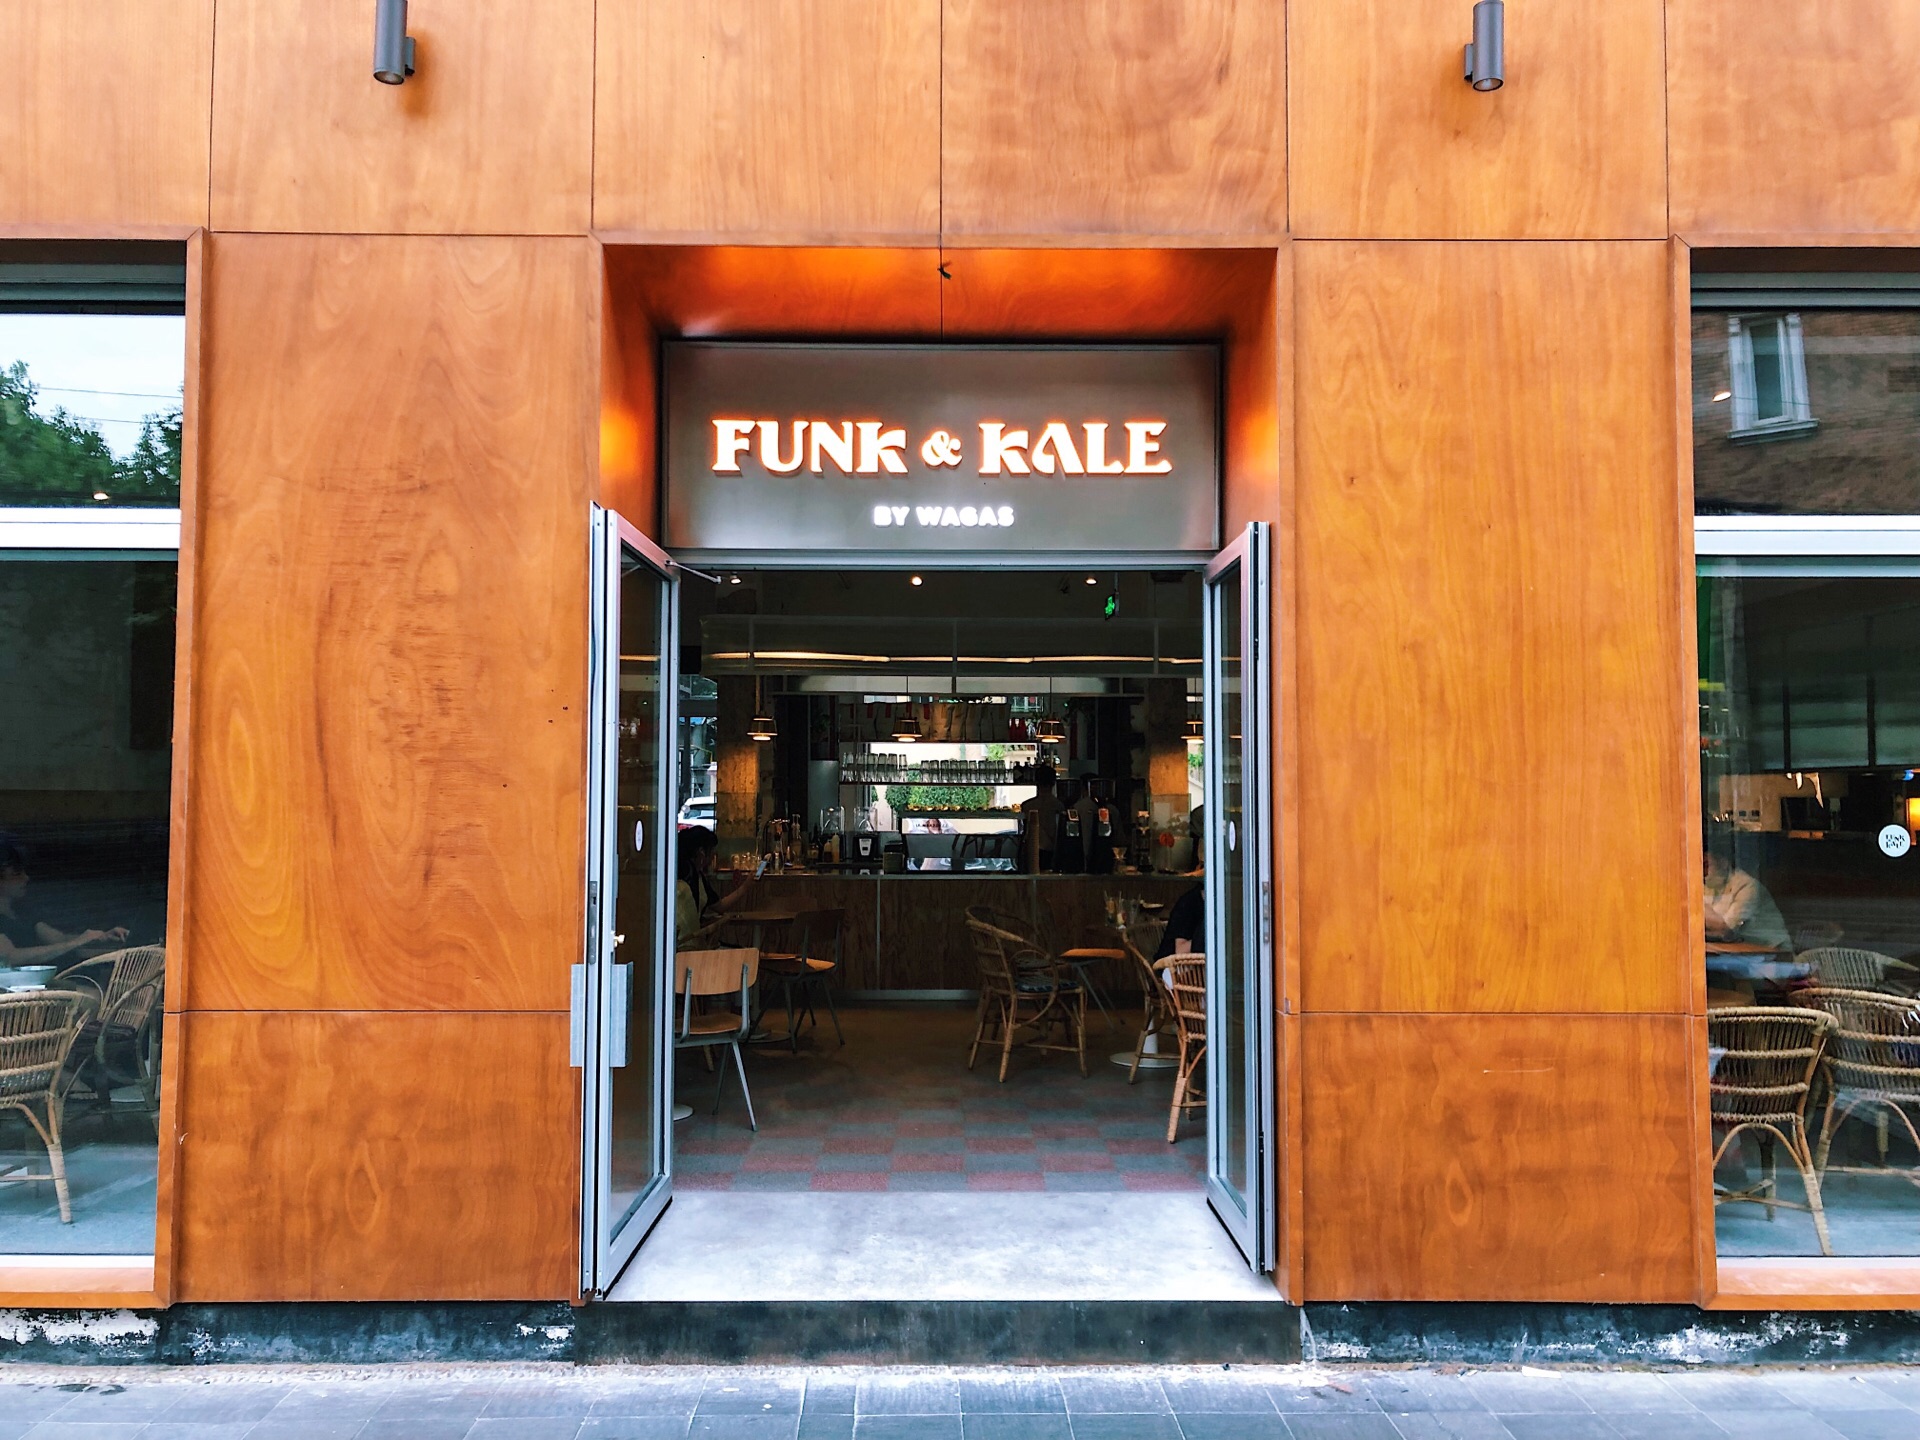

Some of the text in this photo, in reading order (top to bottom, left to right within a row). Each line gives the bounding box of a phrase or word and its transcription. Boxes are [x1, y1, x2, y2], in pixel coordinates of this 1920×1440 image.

[711, 419, 1173, 476] FUNK & KALE
[873, 505, 1015, 527] BY WAGAS
